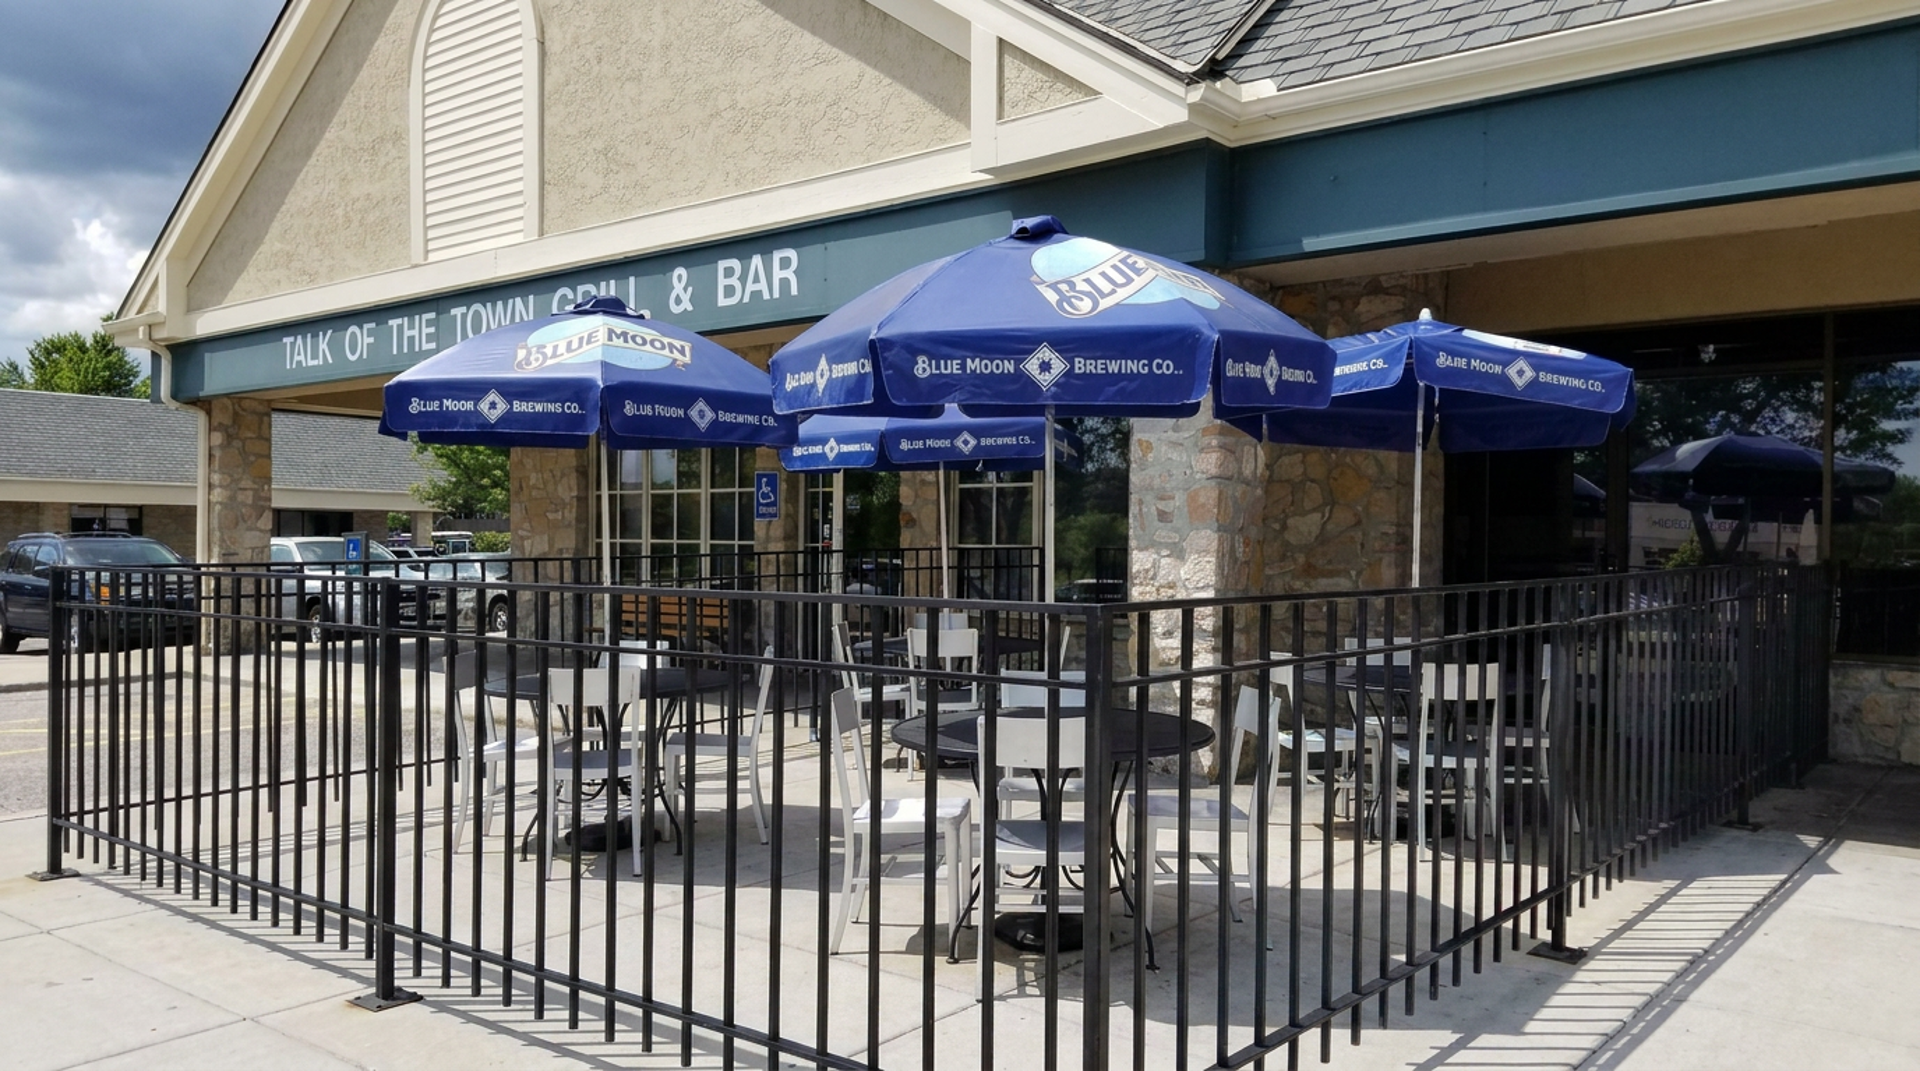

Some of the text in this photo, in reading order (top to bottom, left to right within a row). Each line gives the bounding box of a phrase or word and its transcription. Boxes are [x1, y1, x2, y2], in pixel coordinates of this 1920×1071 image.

[282, 329, 332, 369] TALK
[345, 323, 376, 361] OF
[388, 312, 436, 355] THE
[450, 294, 534, 344] TOWN
[669, 266, 694, 314] &
[716, 248, 798, 308] BAR
[1045, 253, 1150, 316] BLUE
[515, 327, 687, 371] BLUE MOON
[913, 355, 962, 378] BLUE
[966, 358, 1015, 374] MOON
[1074, 357, 1149, 375] BREWING
